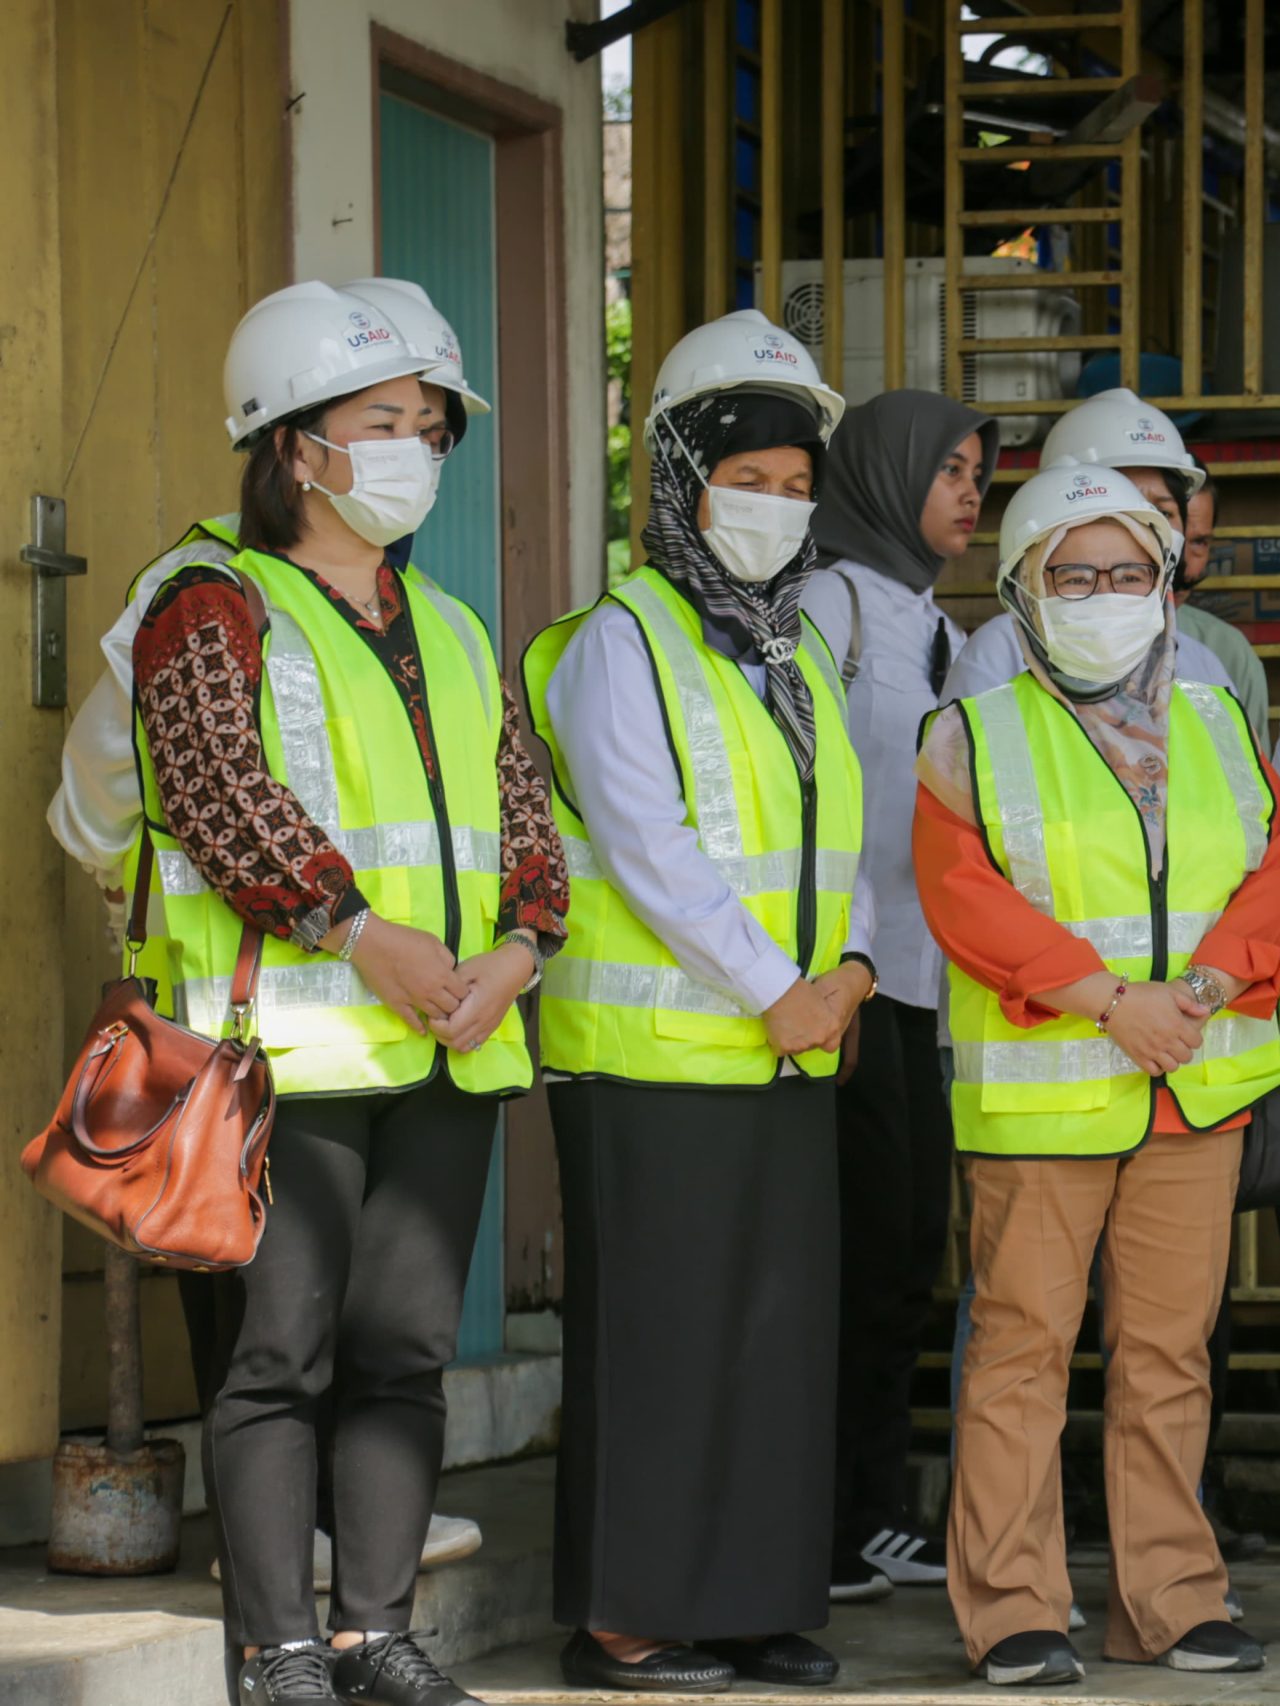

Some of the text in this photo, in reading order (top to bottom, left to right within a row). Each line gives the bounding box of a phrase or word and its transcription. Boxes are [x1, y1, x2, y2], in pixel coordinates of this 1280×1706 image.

[347, 329, 390, 348] USAID
[754, 349, 797, 364] USAID
[1130, 432, 1165, 442] USAID
[1066, 487, 1107, 501] USAID
